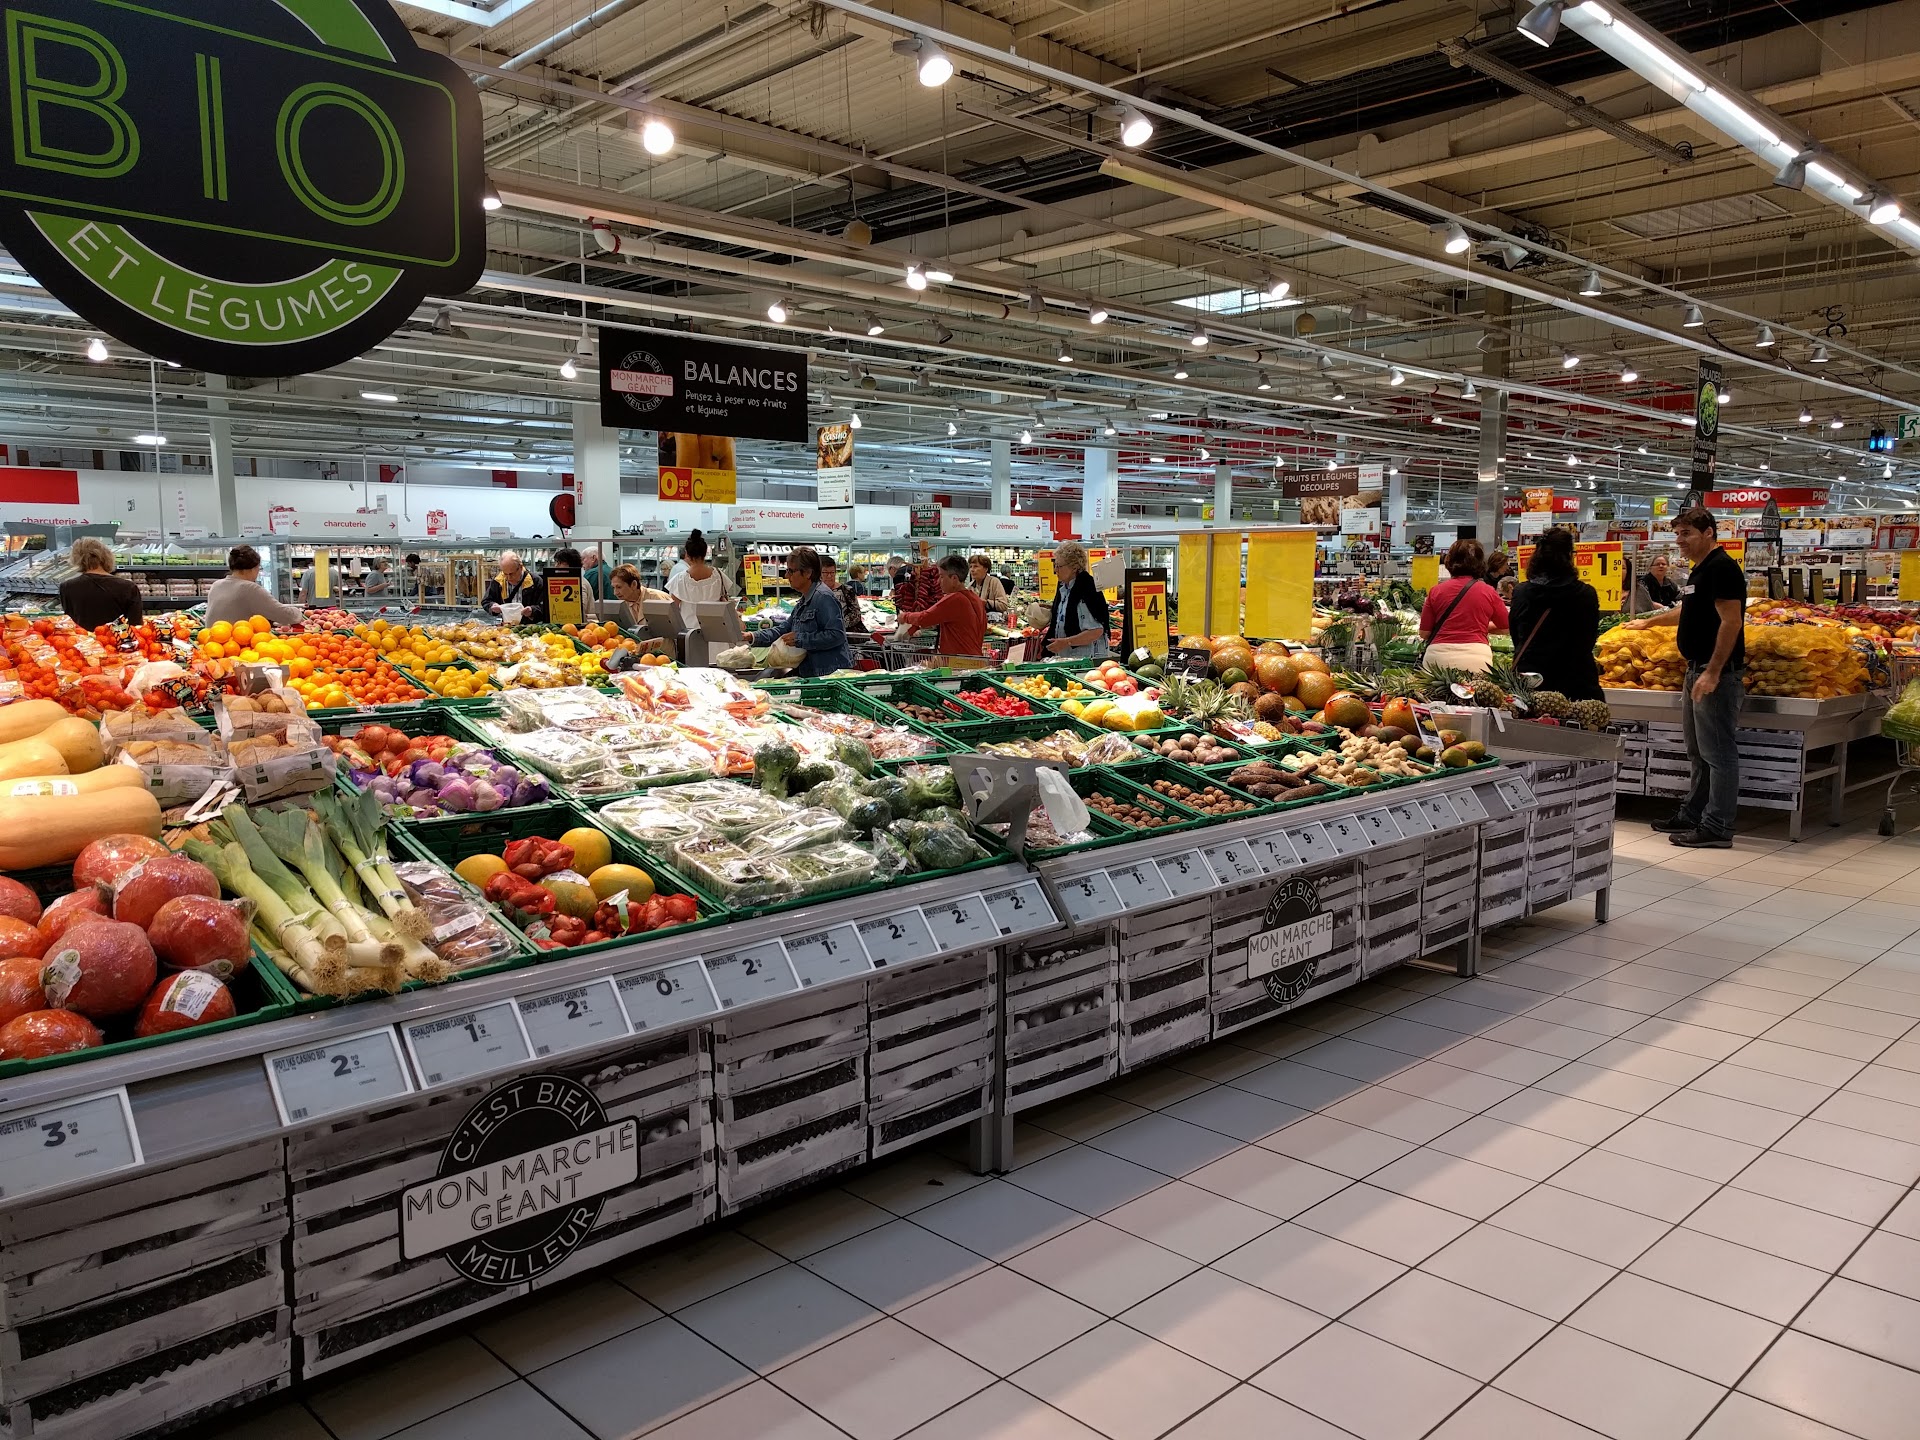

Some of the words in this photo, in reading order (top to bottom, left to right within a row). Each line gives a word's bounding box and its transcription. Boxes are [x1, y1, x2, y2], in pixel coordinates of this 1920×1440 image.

[5, 9, 406, 226] BIO
[67, 222, 140, 281] ET
[151, 262, 373, 331] LÉGUMES
[622, 353, 642, 369] C'EST
[644, 354, 661, 373] BIEN
[612, 371, 633, 382] MON
[684, 360, 798, 393] BALANCES
[624, 393, 661, 411] MEILLEUR
[685, 389, 713, 402] Pensez
[715, 392, 722, 403] à
[724, 396, 745, 405] peser
[747, 398, 760, 407] vos
[762, 398, 787, 410] fruits
[685, 405, 696, 413] et
[698, 404, 728, 418] légumes
[661, 471, 678, 497] 0
[679, 480, 689, 488] 89
[1284, 474, 1309, 483] FRUITS
[1311, 473, 1320, 482] ET
[1321, 471, 1357, 481] LÉGUMES
[1722, 491, 1771, 503] PROMO
[21, 517, 78, 526] charcuterie
[767, 510, 804, 519] charcuterie
[1881, 514, 1919, 524] Casino
[324, 520, 367, 528] charcuterie
[811, 522, 840, 530] crèmerie
[1609, 520, 1648, 528] Casino
[1597, 553, 1608, 576] 1
[562, 585, 574, 602] 2
[1147, 595, 1159, 620] 4
[1303, 833, 1312, 844] 9
[1225, 850, 1236, 862] 8
[1265, 842, 1274, 853] 7
[1176, 862, 1188, 874] 3
[1132, 872, 1142, 885] 1
[1080, 883, 1092, 897] 3
[1010, 896, 1023, 910] 2
[1265, 882, 1293, 925] C'EST
[1296, 882, 1318, 912] BIEN
[951, 909, 965, 924] 2
[887, 924, 903, 940] 2
[1249, 931, 1279, 957] MON
[1282, 913, 1332, 946] MARCHÉ
[821, 940, 833, 956] 1
[1271, 940, 1313, 969] GÉANT
[742, 958, 758, 976] 2
[656, 979, 672, 996] 0
[1266, 962, 1316, 1001] MEILLEUR
[519, 998, 537, 1011] OIGNON
[564, 990, 581, 1002] CASINO
[580, 988, 588, 998] BIO
[564, 1000, 582, 1020] 2
[410, 1023, 436, 1039] ECHALOTE
[435, 1020, 451, 1034] 250GR
[451, 1016, 468, 1030] CASINO
[467, 1014, 477, 1024] BIO
[464, 1023, 479, 1042] 1
[296, 1052, 315, 1065] CASINO
[315, 1050, 326, 1060] BIO
[330, 1055, 352, 1077] 2
[452, 1086, 524, 1162] C'EST
[537, 1082, 596, 1127] BIEN
[41, 1121, 67, 1147] 3
[67, 1122, 78, 1130] 99
[74, 1148, 98, 1158] ORIGINE
[406, 1171, 488, 1221] MON
[501, 1123, 634, 1191] MARCHÉ
[470, 1172, 583, 1232] GÉANT
[460, 1206, 595, 1280] MEILLEUR
